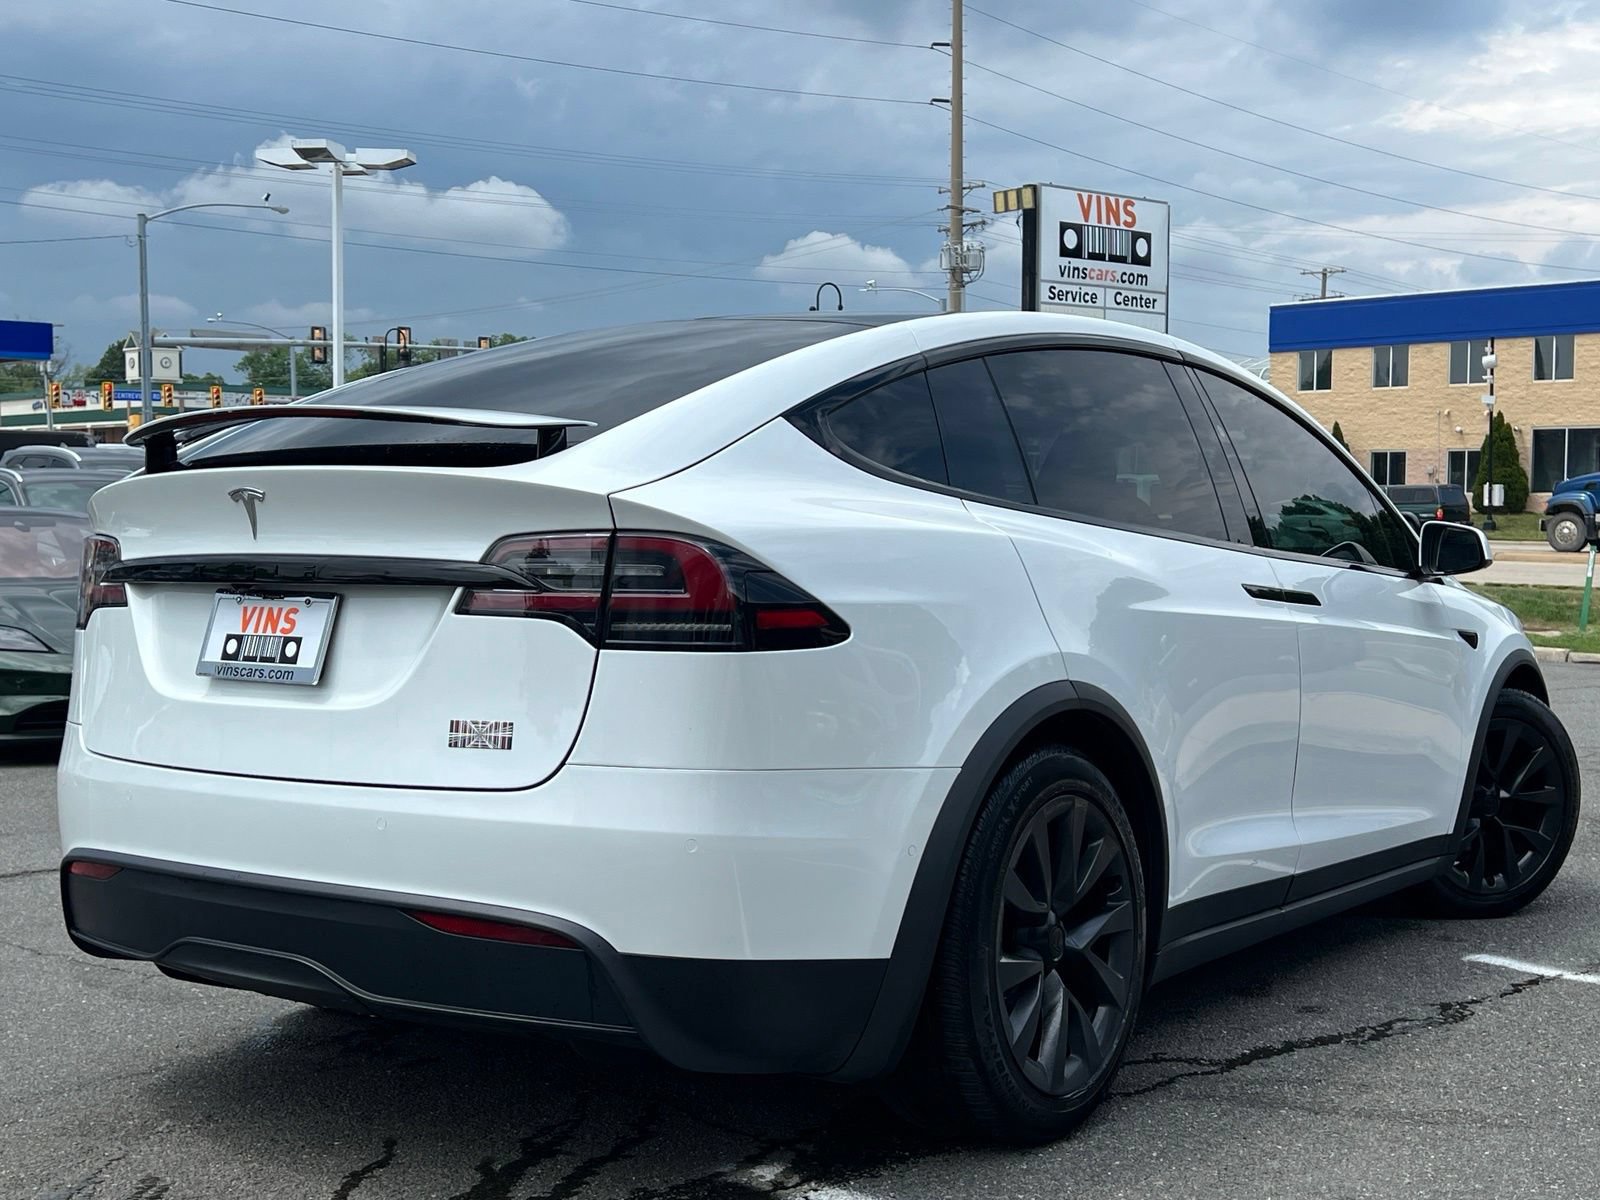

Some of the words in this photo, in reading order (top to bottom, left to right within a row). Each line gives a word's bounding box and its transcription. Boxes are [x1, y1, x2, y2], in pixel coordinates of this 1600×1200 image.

[1076, 193, 1137, 229] VINS
[1059, 261, 1148, 286] vinscars.com
[1048, 285, 1098, 304] Service
[1114, 291, 1157, 309] Center
[114, 391, 142, 400] CENTREVI
[241, 606, 300, 634] VINS
[217, 664, 294, 681] vinscars.com
